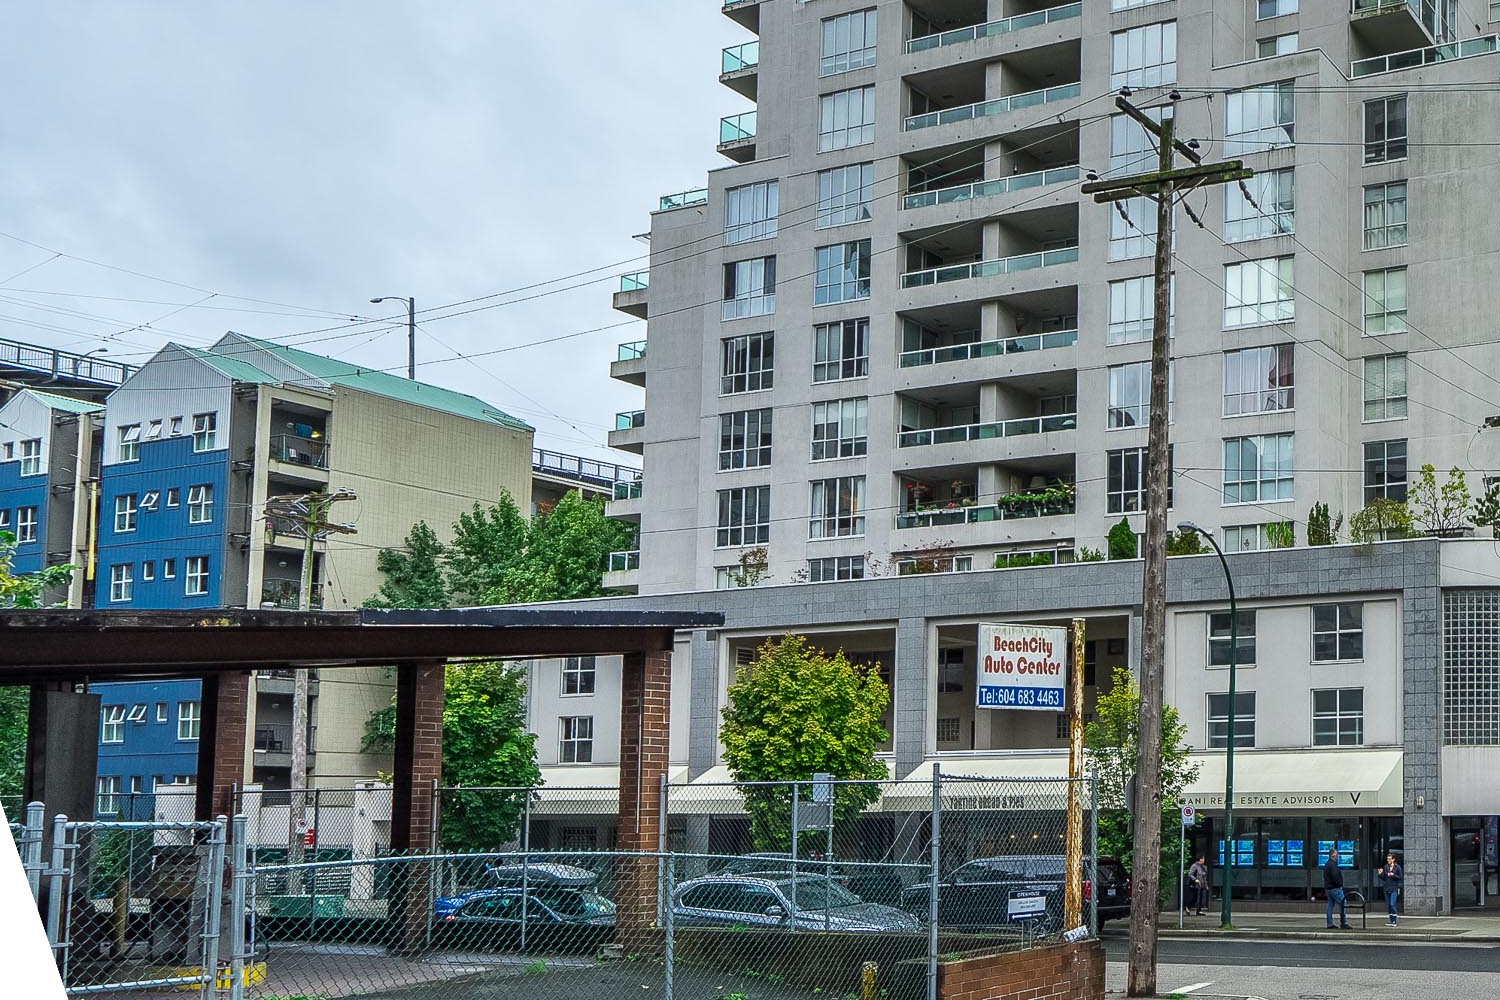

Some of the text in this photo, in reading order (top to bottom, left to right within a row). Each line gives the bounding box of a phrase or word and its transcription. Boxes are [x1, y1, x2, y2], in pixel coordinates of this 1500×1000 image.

[994, 636, 1053, 658] BeachCity
[984, 655, 1061, 675] Auto Center
[981, 688, 1059, 705] Tel:604 683 4463
[1241, 796, 1277, 805] ESTATE
[1283, 796, 1335, 804] ADVISORS
